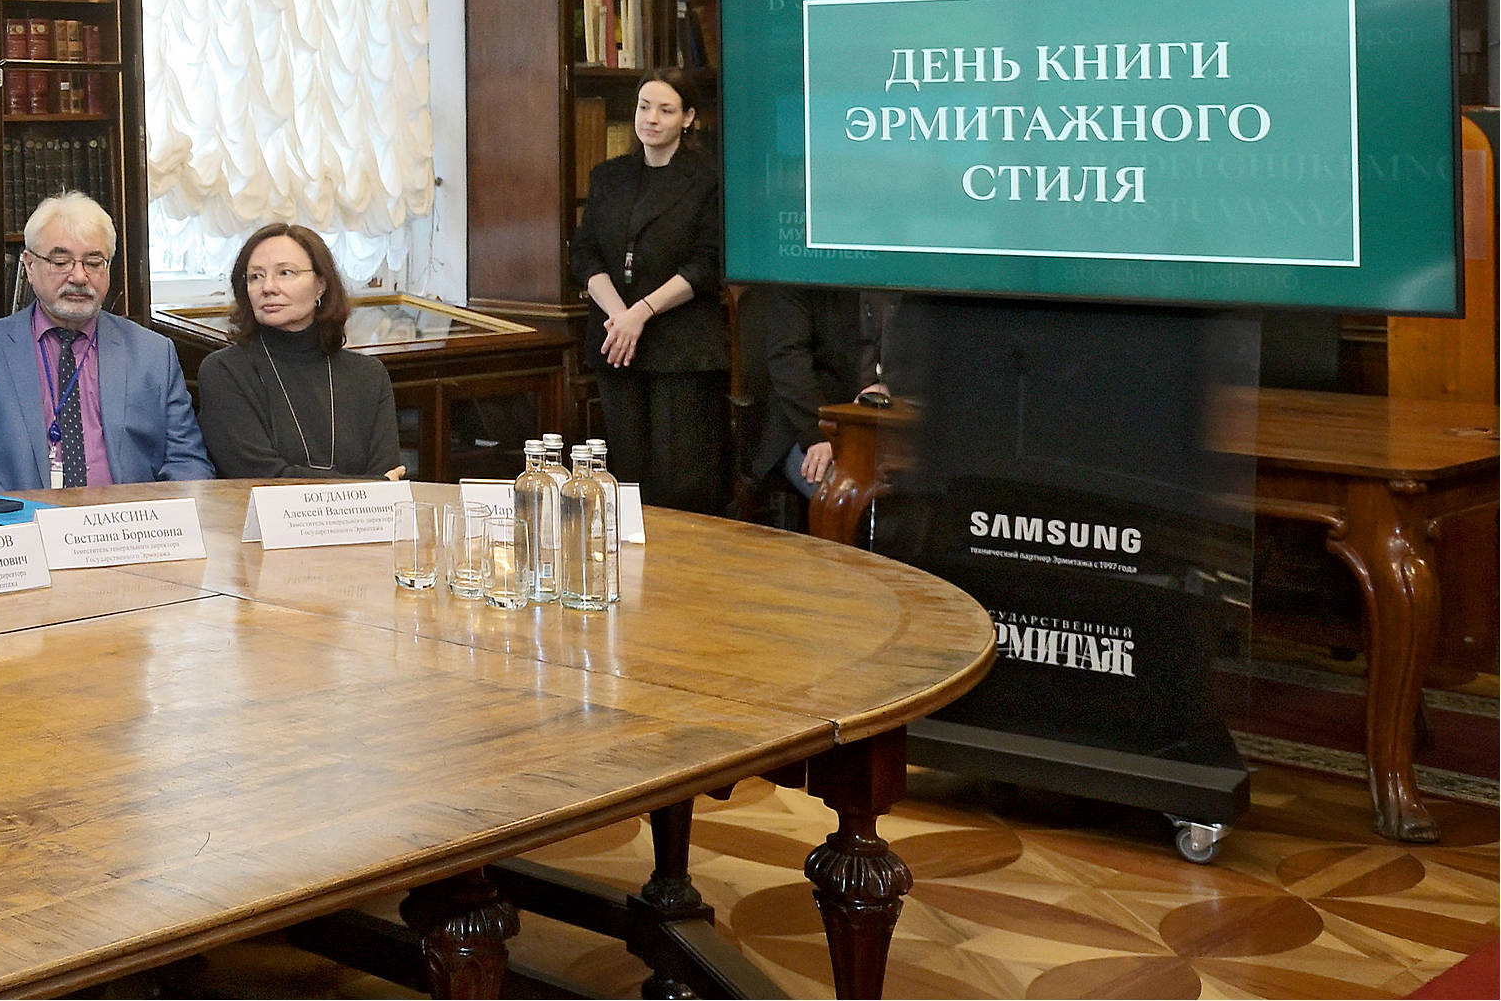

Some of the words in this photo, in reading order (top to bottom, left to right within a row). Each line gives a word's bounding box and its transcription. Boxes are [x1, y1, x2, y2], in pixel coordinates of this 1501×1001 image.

[885, 46, 1021, 93] ДЕНЬ
[1036, 40, 1230, 83] КНИГИ
[844, 102, 1271, 143] ЭРМИТАЖНОГО
[961, 163, 1147, 203] СТИЛЯ
[304, 490, 367, 503] БОГДАНОВ
[83, 509, 159, 527] АДАКСИНА
[283, 507, 323, 519] Алексей
[325, 505, 394, 516] Валентинович
[64, 531, 119, 545] Светлана
[122, 527, 183, 542] Борисовна
[970, 510, 1142, 554] SAMSUNG
[1051, 555, 1093, 568] Эрмитажа
[1099, 561, 1117, 570] 1997
[1118, 565, 1137, 574] года
[994, 622, 1136, 677] РМИТАЖ
